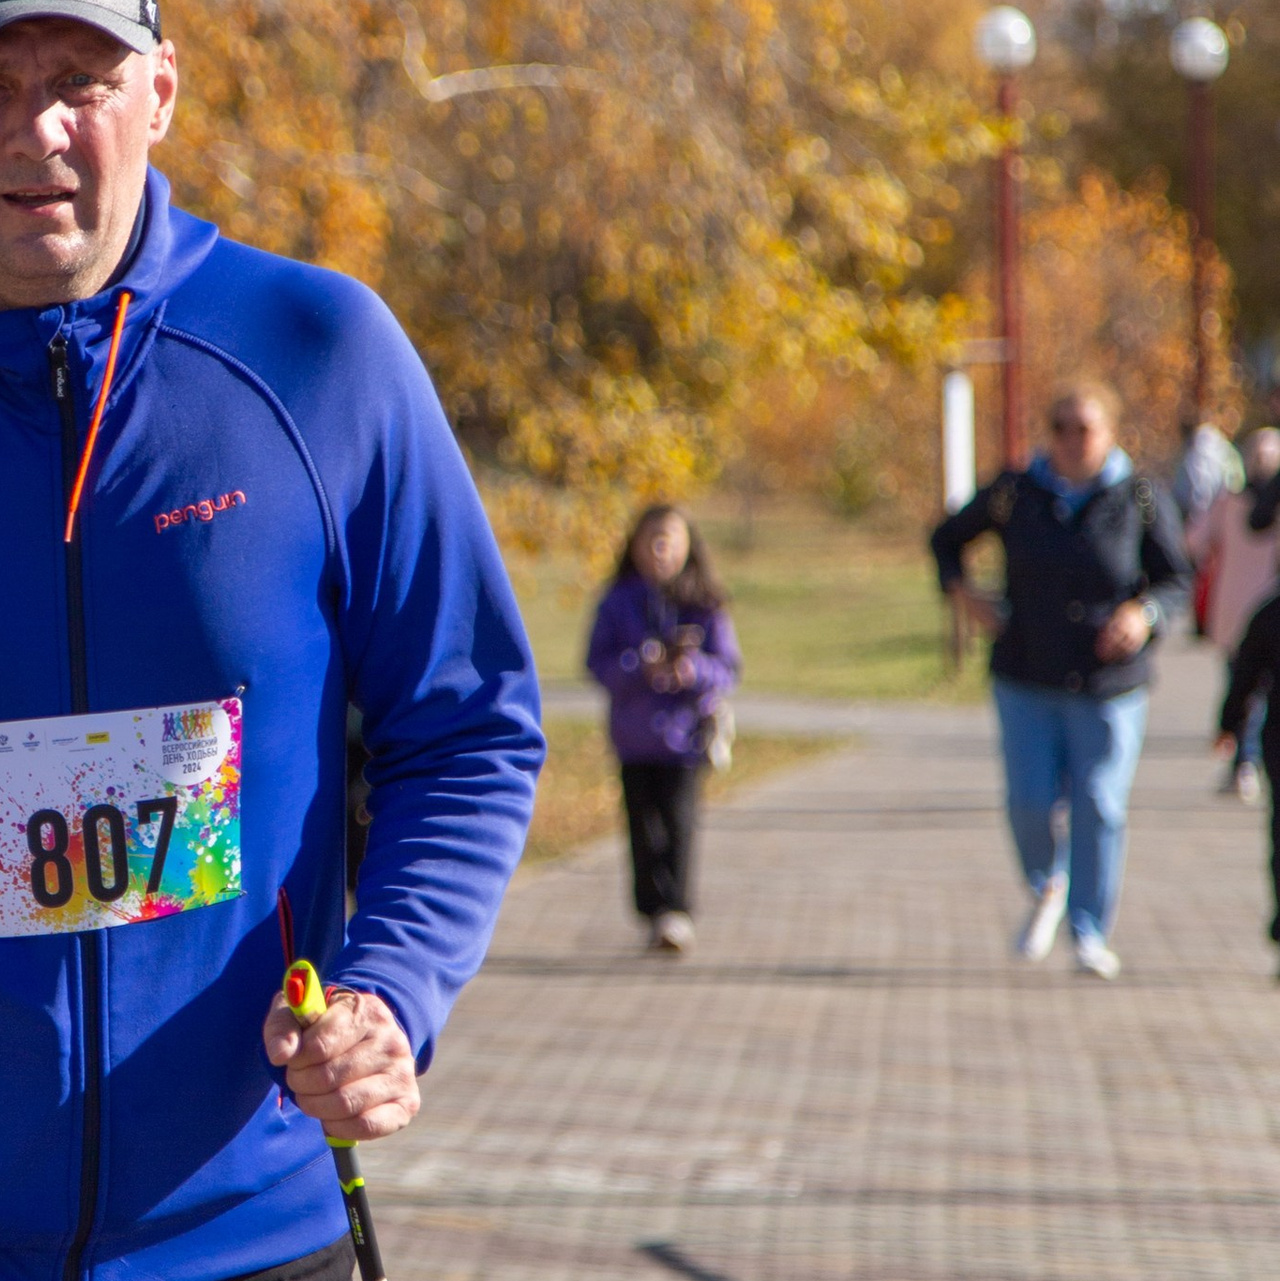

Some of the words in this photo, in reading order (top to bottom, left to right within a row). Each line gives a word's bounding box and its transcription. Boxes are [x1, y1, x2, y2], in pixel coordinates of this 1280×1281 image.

[154, 490, 246, 534] penguin
[162, 736, 217, 754] ВСЕРОССИЙСКИЙ
[163, 753, 184, 766] ДЕНЬ
[186, 746, 217, 761] ХОДЬБЫ
[183, 762, 201, 774] 2024
[26, 795, 178, 909] 807
